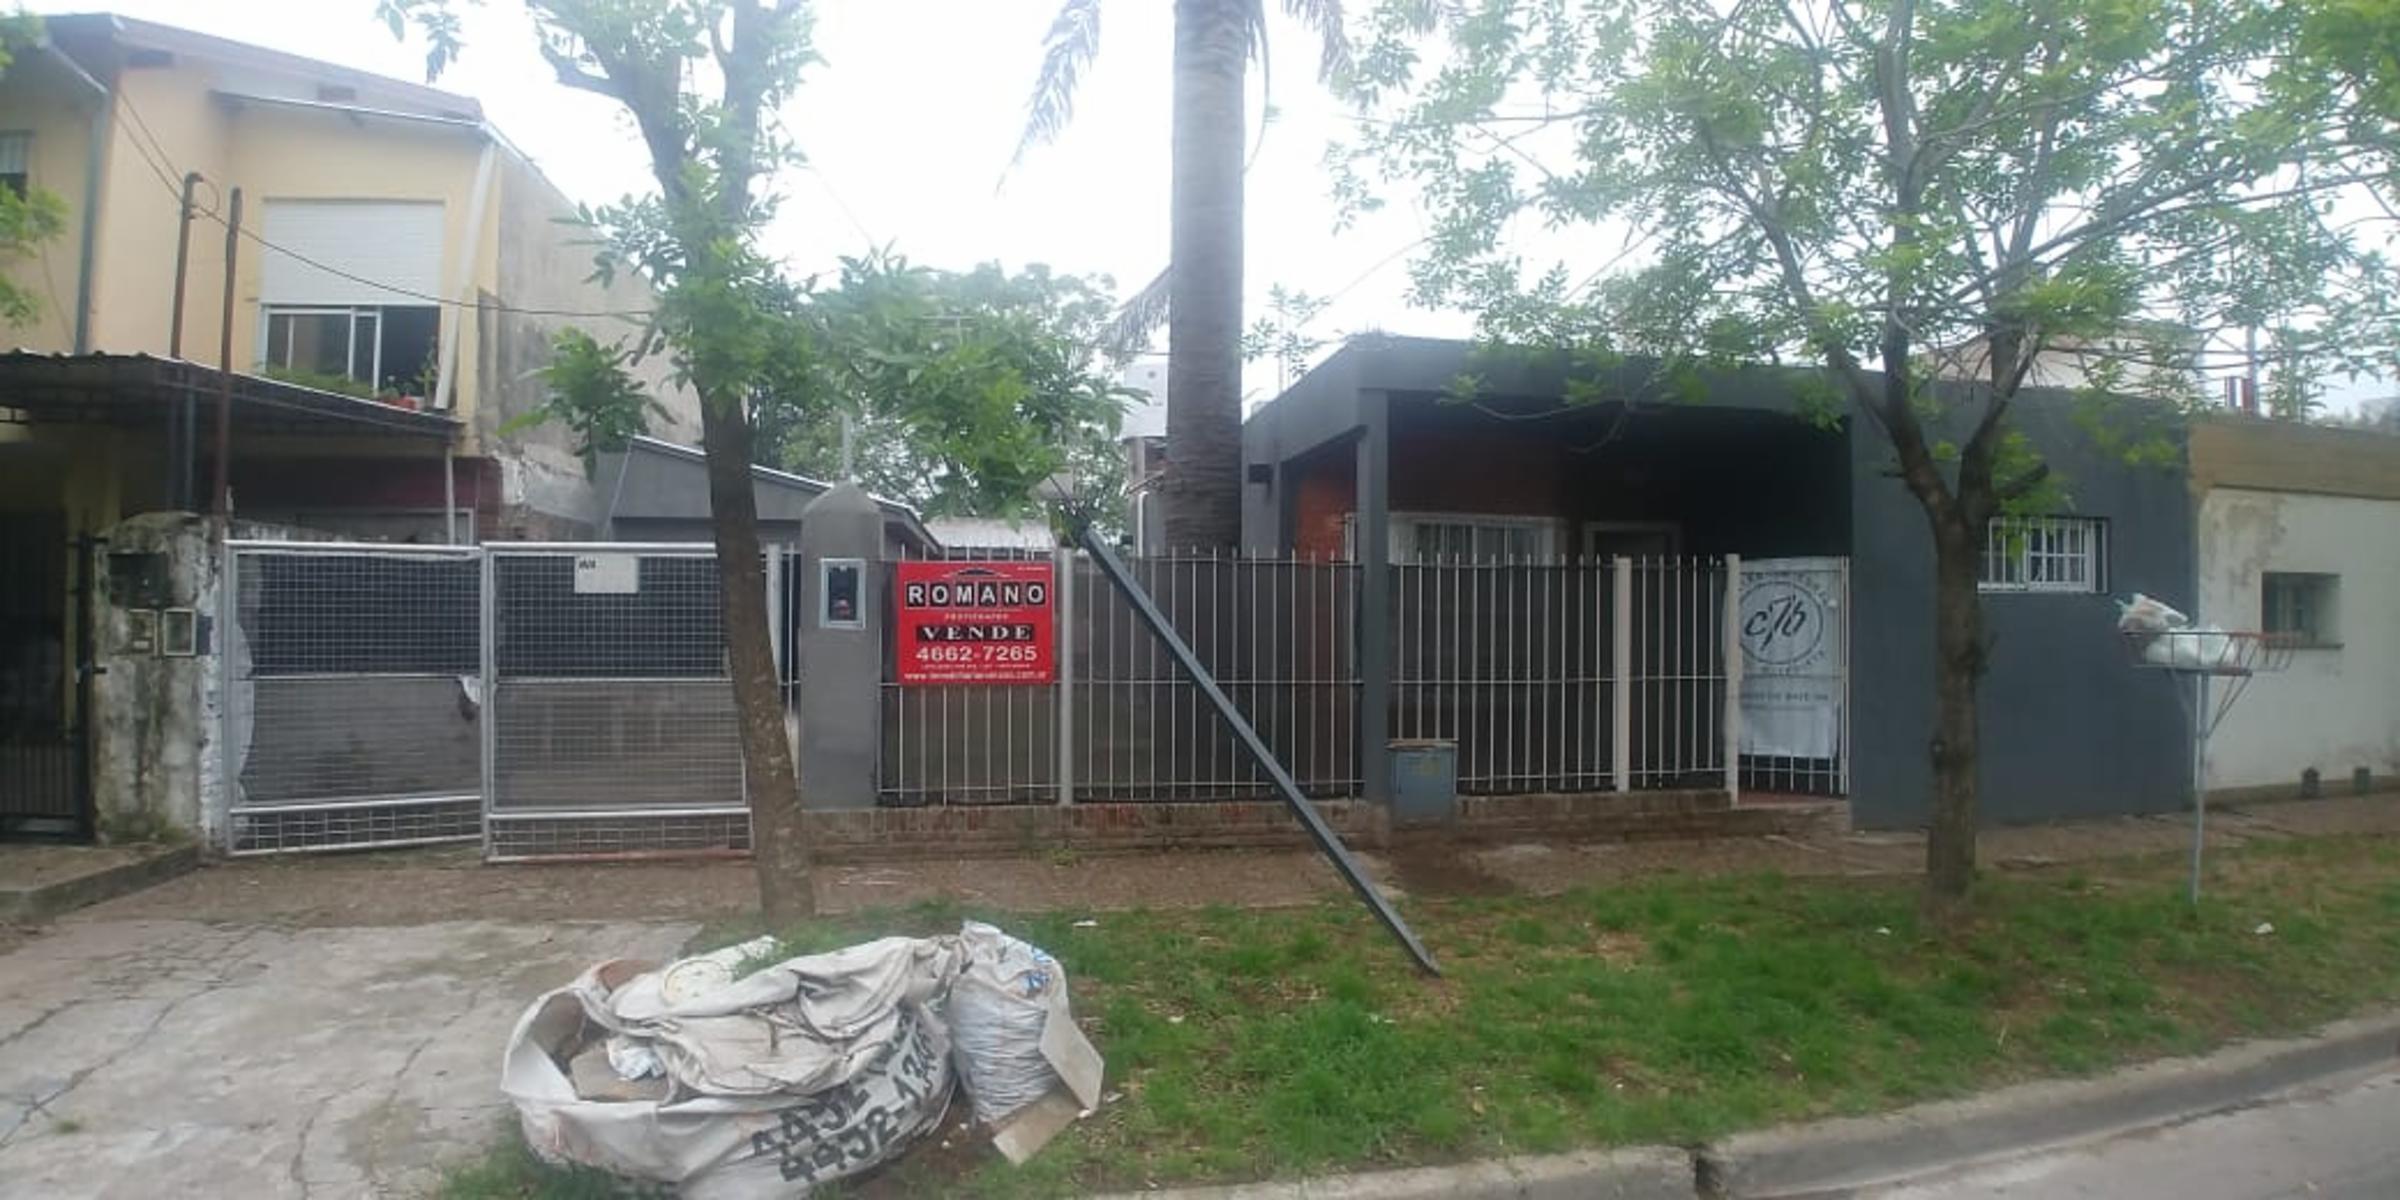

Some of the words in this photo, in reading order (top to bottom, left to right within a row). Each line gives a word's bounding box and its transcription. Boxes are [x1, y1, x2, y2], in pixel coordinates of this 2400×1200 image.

[907, 584, 1045, 604] ROMANO
[923, 625, 1031, 641] VENDE
[915, 645, 1038, 662] 4662-7265
